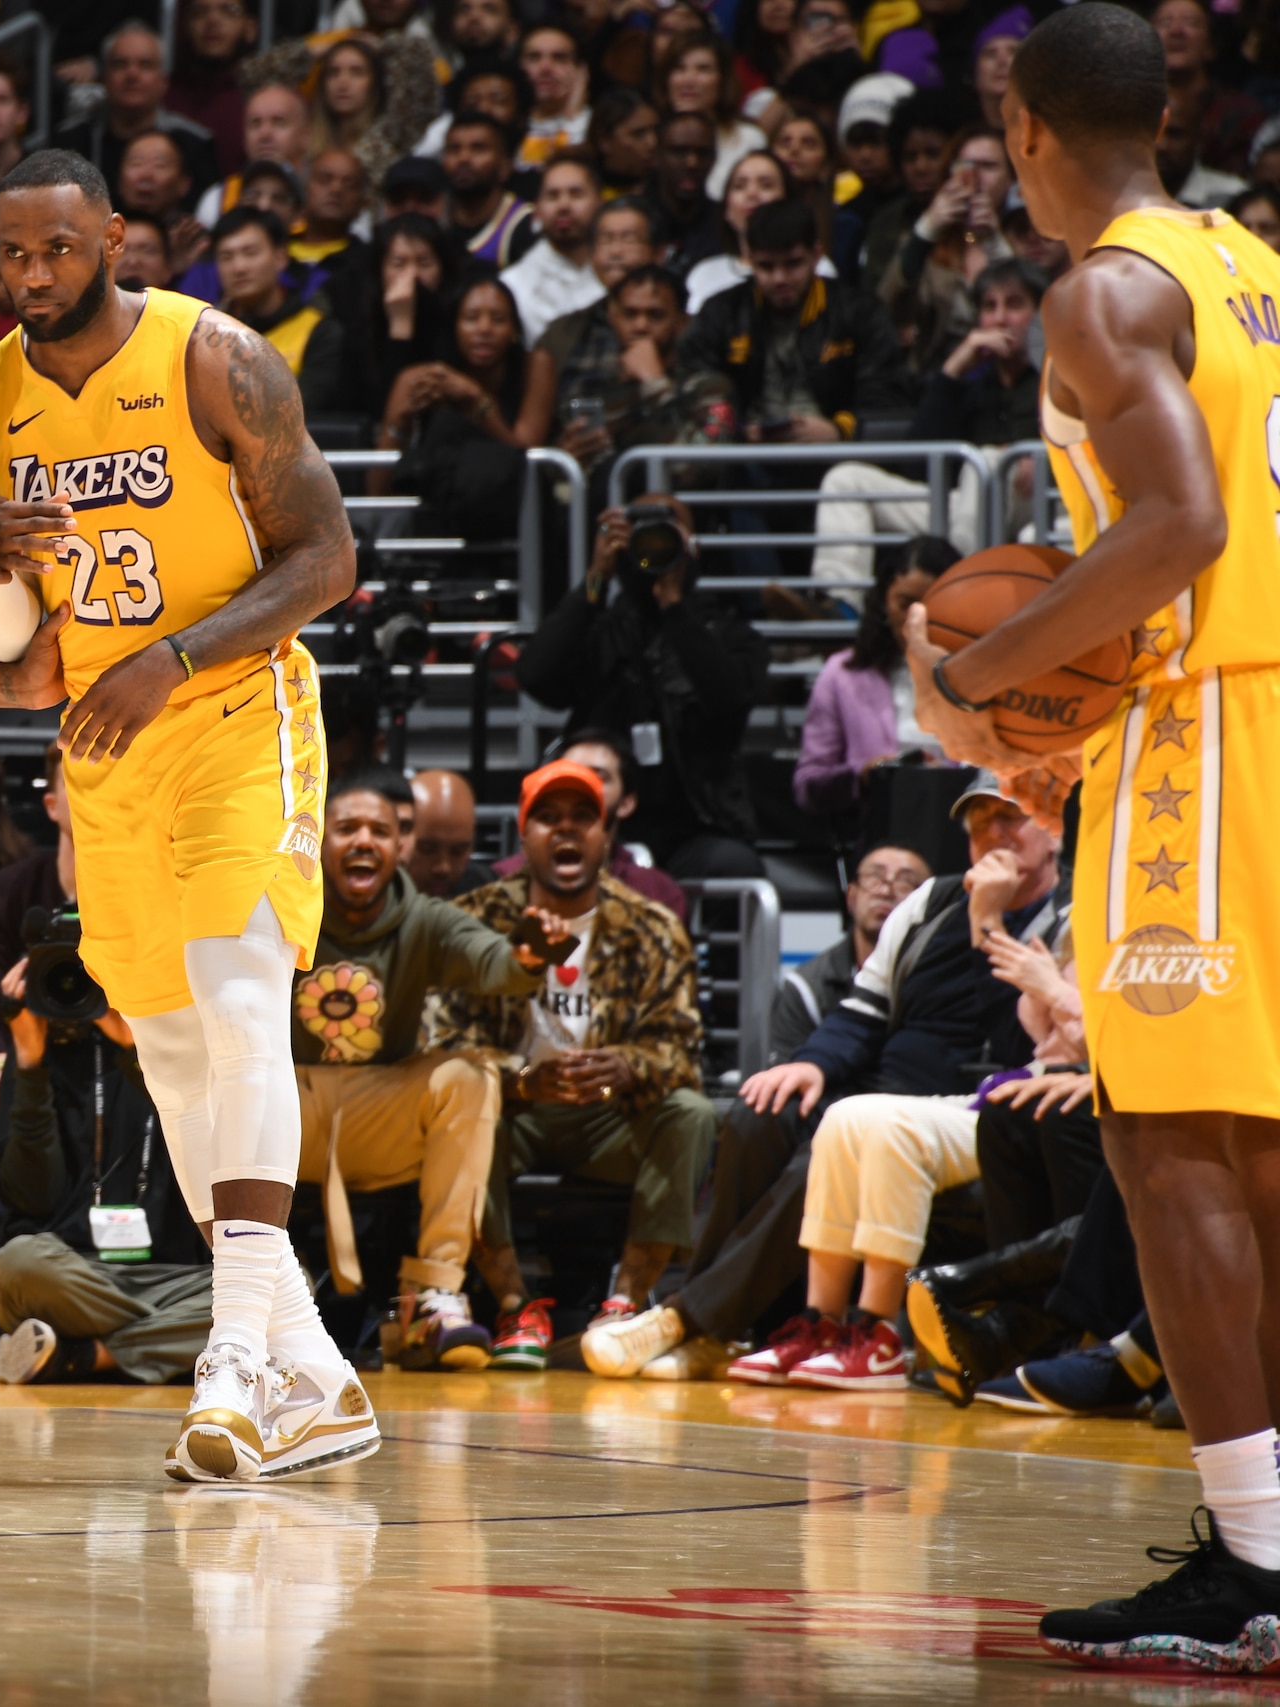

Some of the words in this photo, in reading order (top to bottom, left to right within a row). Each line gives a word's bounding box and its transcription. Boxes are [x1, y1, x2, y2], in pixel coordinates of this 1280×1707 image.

[117, 393, 164, 411] wish
[9, 445, 173, 511] LAKERS
[49, 528, 165, 627] 23
[1094, 943, 1242, 996] LAKERS
[1135, 943, 1164, 955] LOS
[1166, 943, 1237, 955] ANGELES
